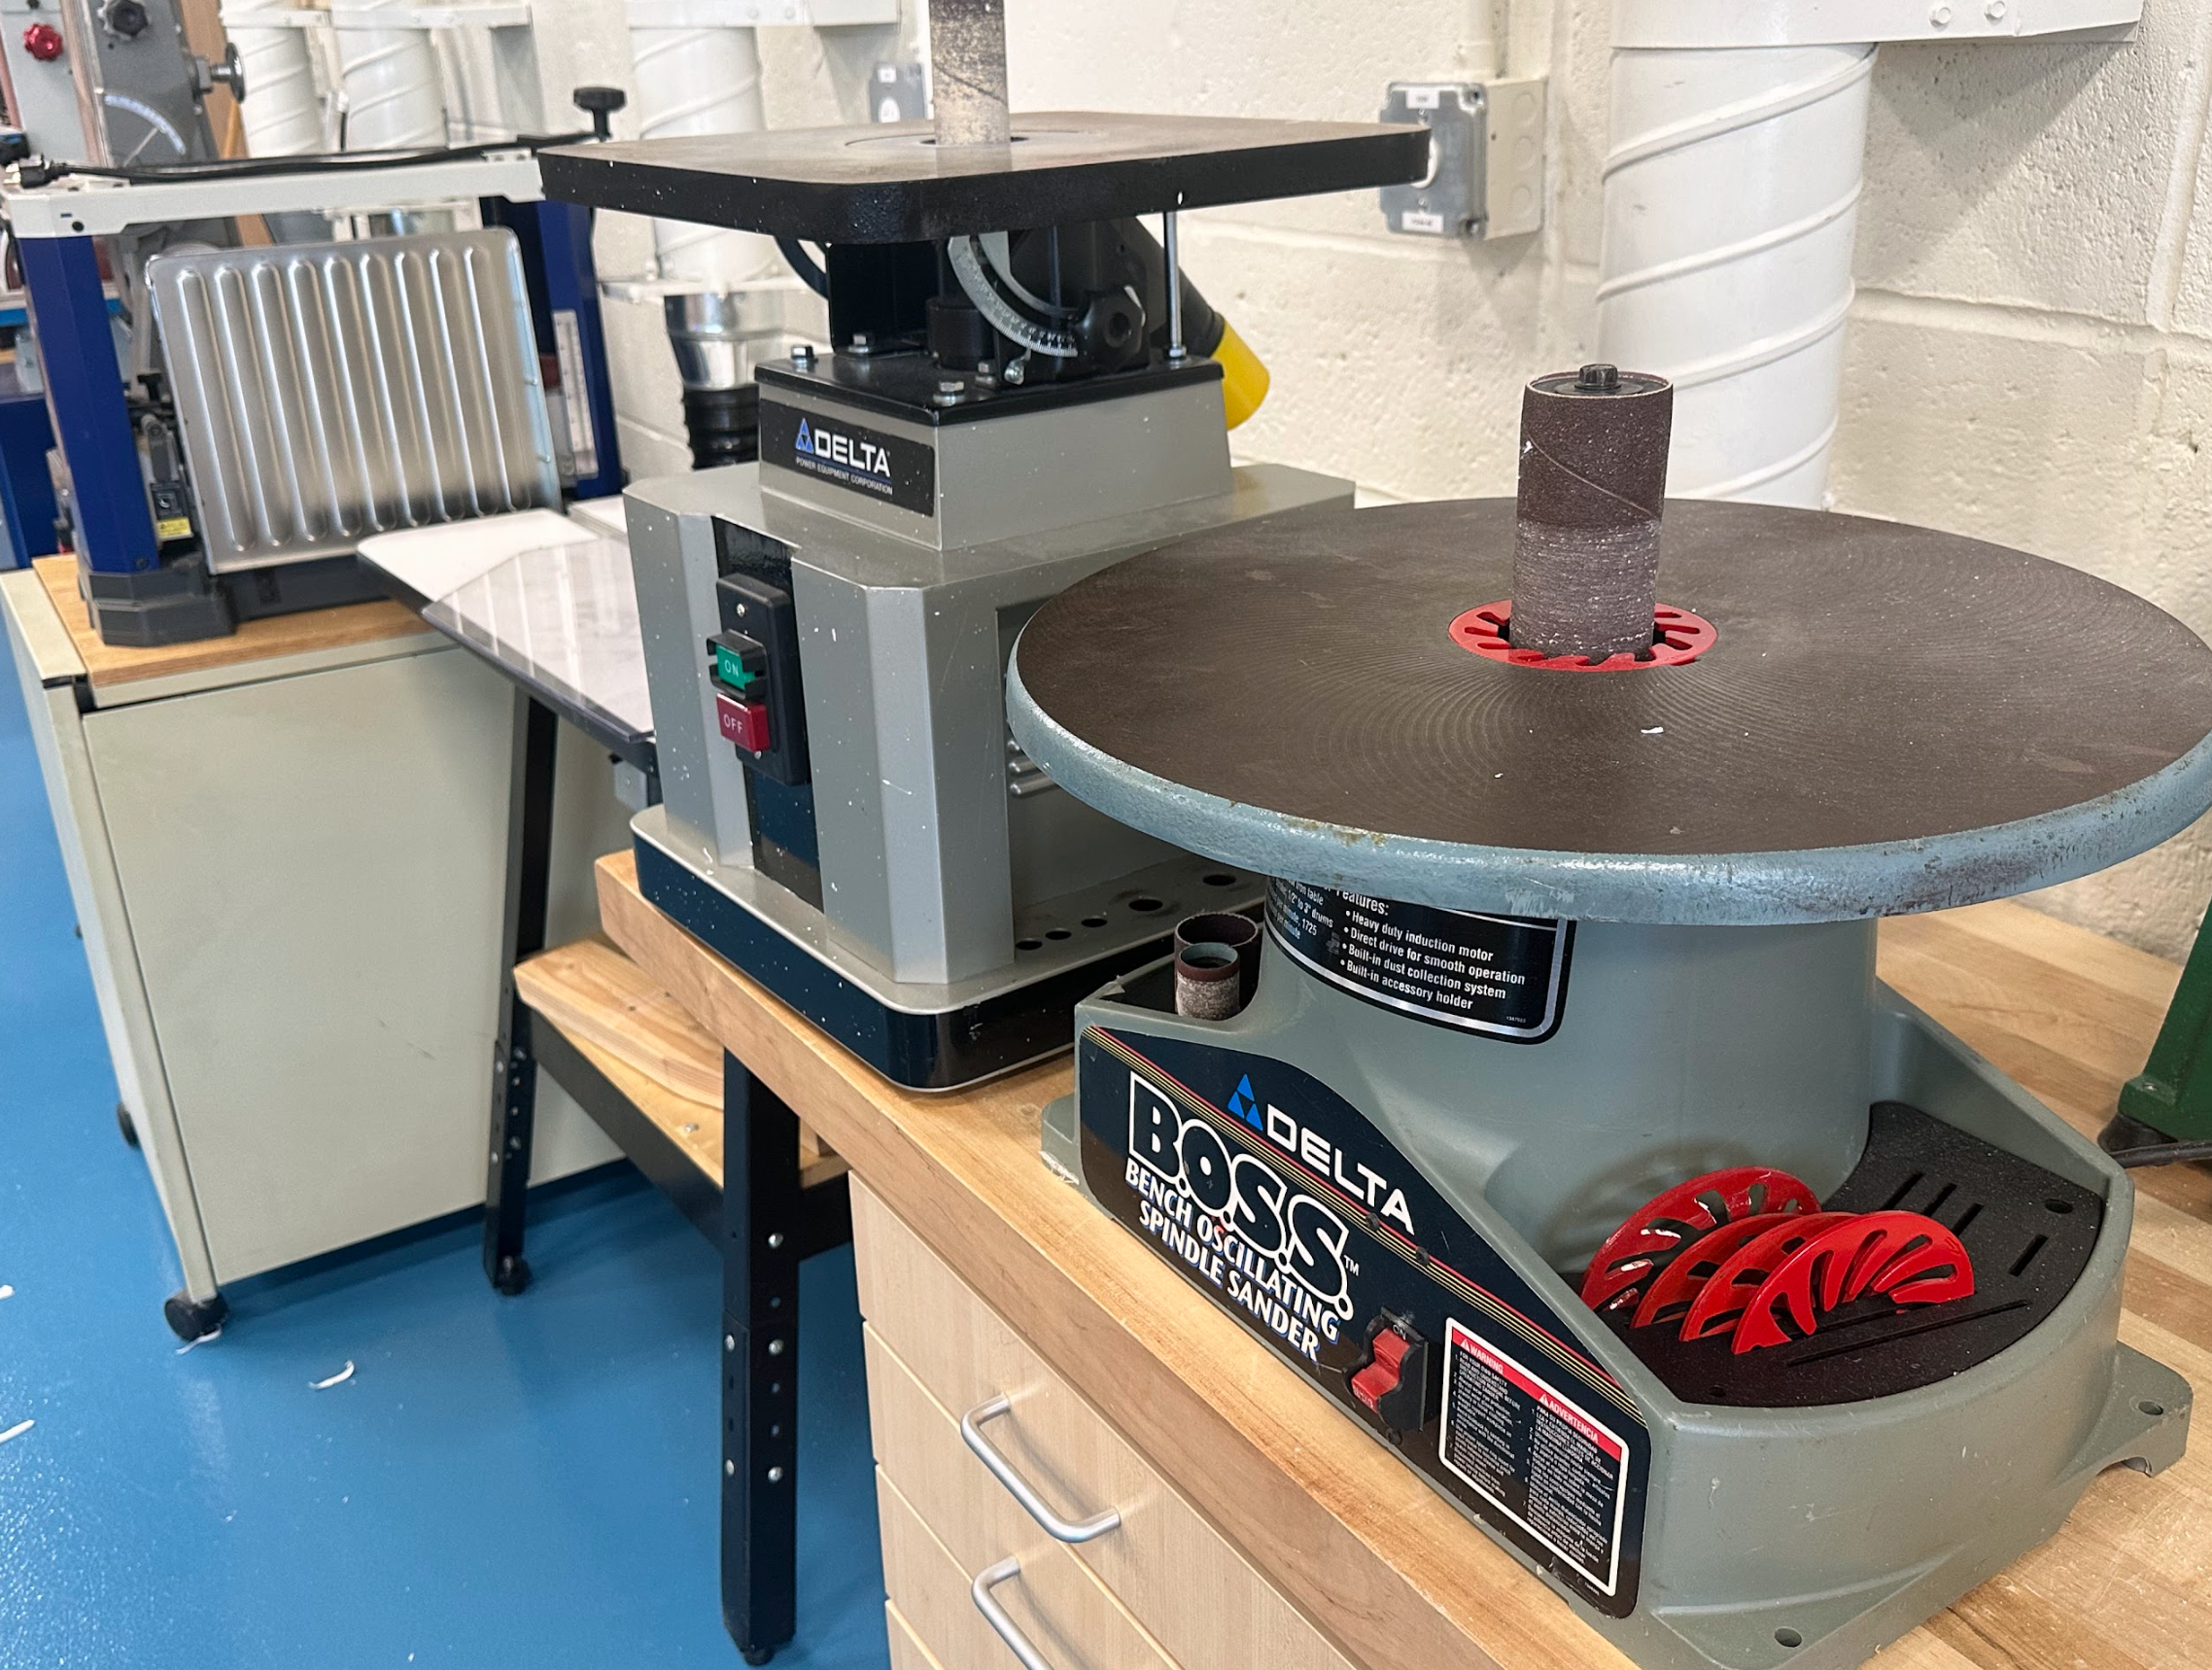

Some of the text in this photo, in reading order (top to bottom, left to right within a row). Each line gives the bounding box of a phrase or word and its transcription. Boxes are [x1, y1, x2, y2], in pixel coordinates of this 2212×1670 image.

[795, 456, 893, 496] POWER EQUIPMENT CORPORATION
[814, 429, 891, 477] DELTA
[724, 659, 739, 678] ON
[723, 713, 743, 734] OFF
[1301, 918, 1318, 936] 1725
[1311, 909, 1333, 928] drums
[1352, 910, 1494, 962] Heavy duty induction motor
[1348, 942, 1506, 999] Built-in dust collection system
[1350, 926, 1526, 986] Direct drive for smooth operation
[1346, 959, 1474, 1010] Built-in accessory holder
[1266, 1103, 1415, 1236] DELTA
[1125, 1157, 1340, 1343] BENCH OSCILLATING
[1140, 1200, 1321, 1364] SPINDLE SANDER
[1392, 1324, 1406, 1340] ON
[1469, 1344, 1503, 1372] WARNING
[1548, 1399, 1599, 1444] ADVERTENCIA
